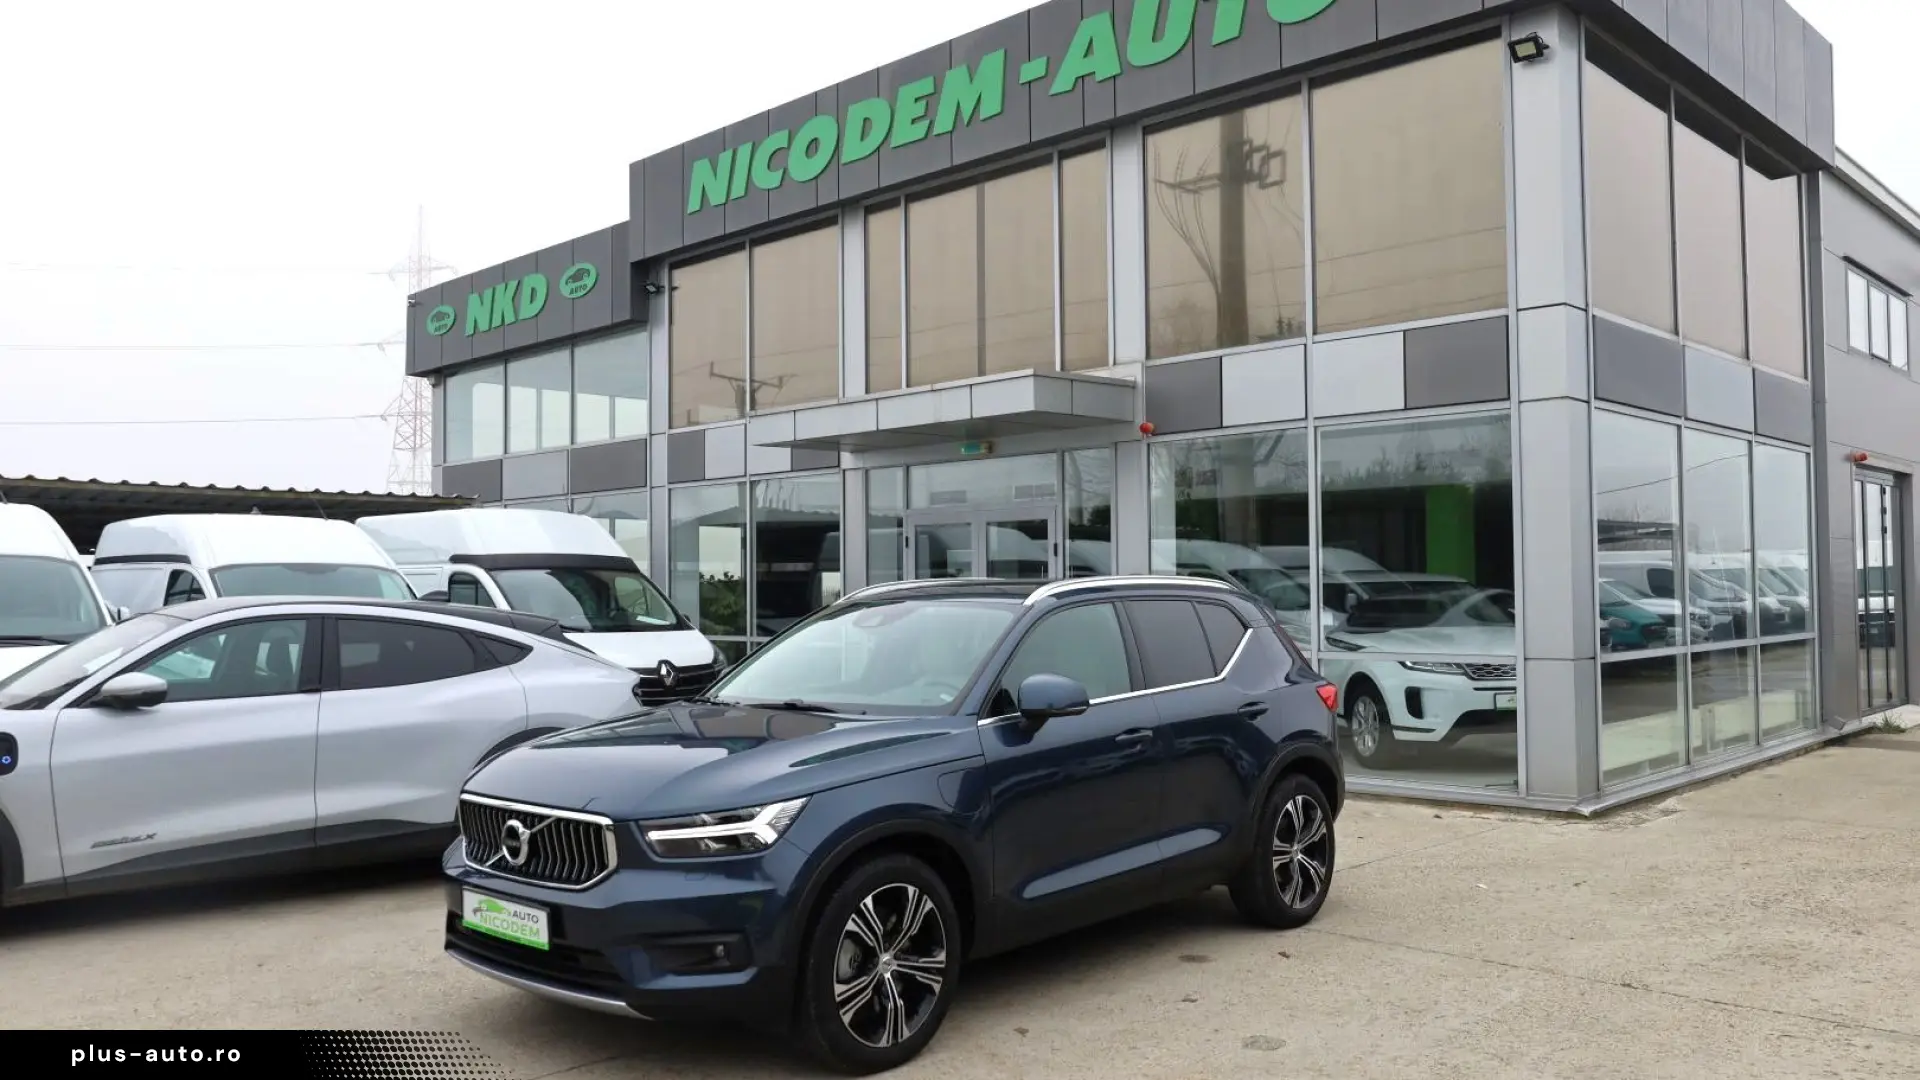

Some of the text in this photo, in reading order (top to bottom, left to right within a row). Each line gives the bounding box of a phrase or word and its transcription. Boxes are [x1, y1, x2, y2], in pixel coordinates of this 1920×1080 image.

[687, 0, 1336, 215] NICODEM-AU
[569, 283, 588, 295] AUTO
[464, 273, 549, 337] NKD
[480, 913, 540, 938] NICODEM
[512, 910, 539, 924] AUTO
